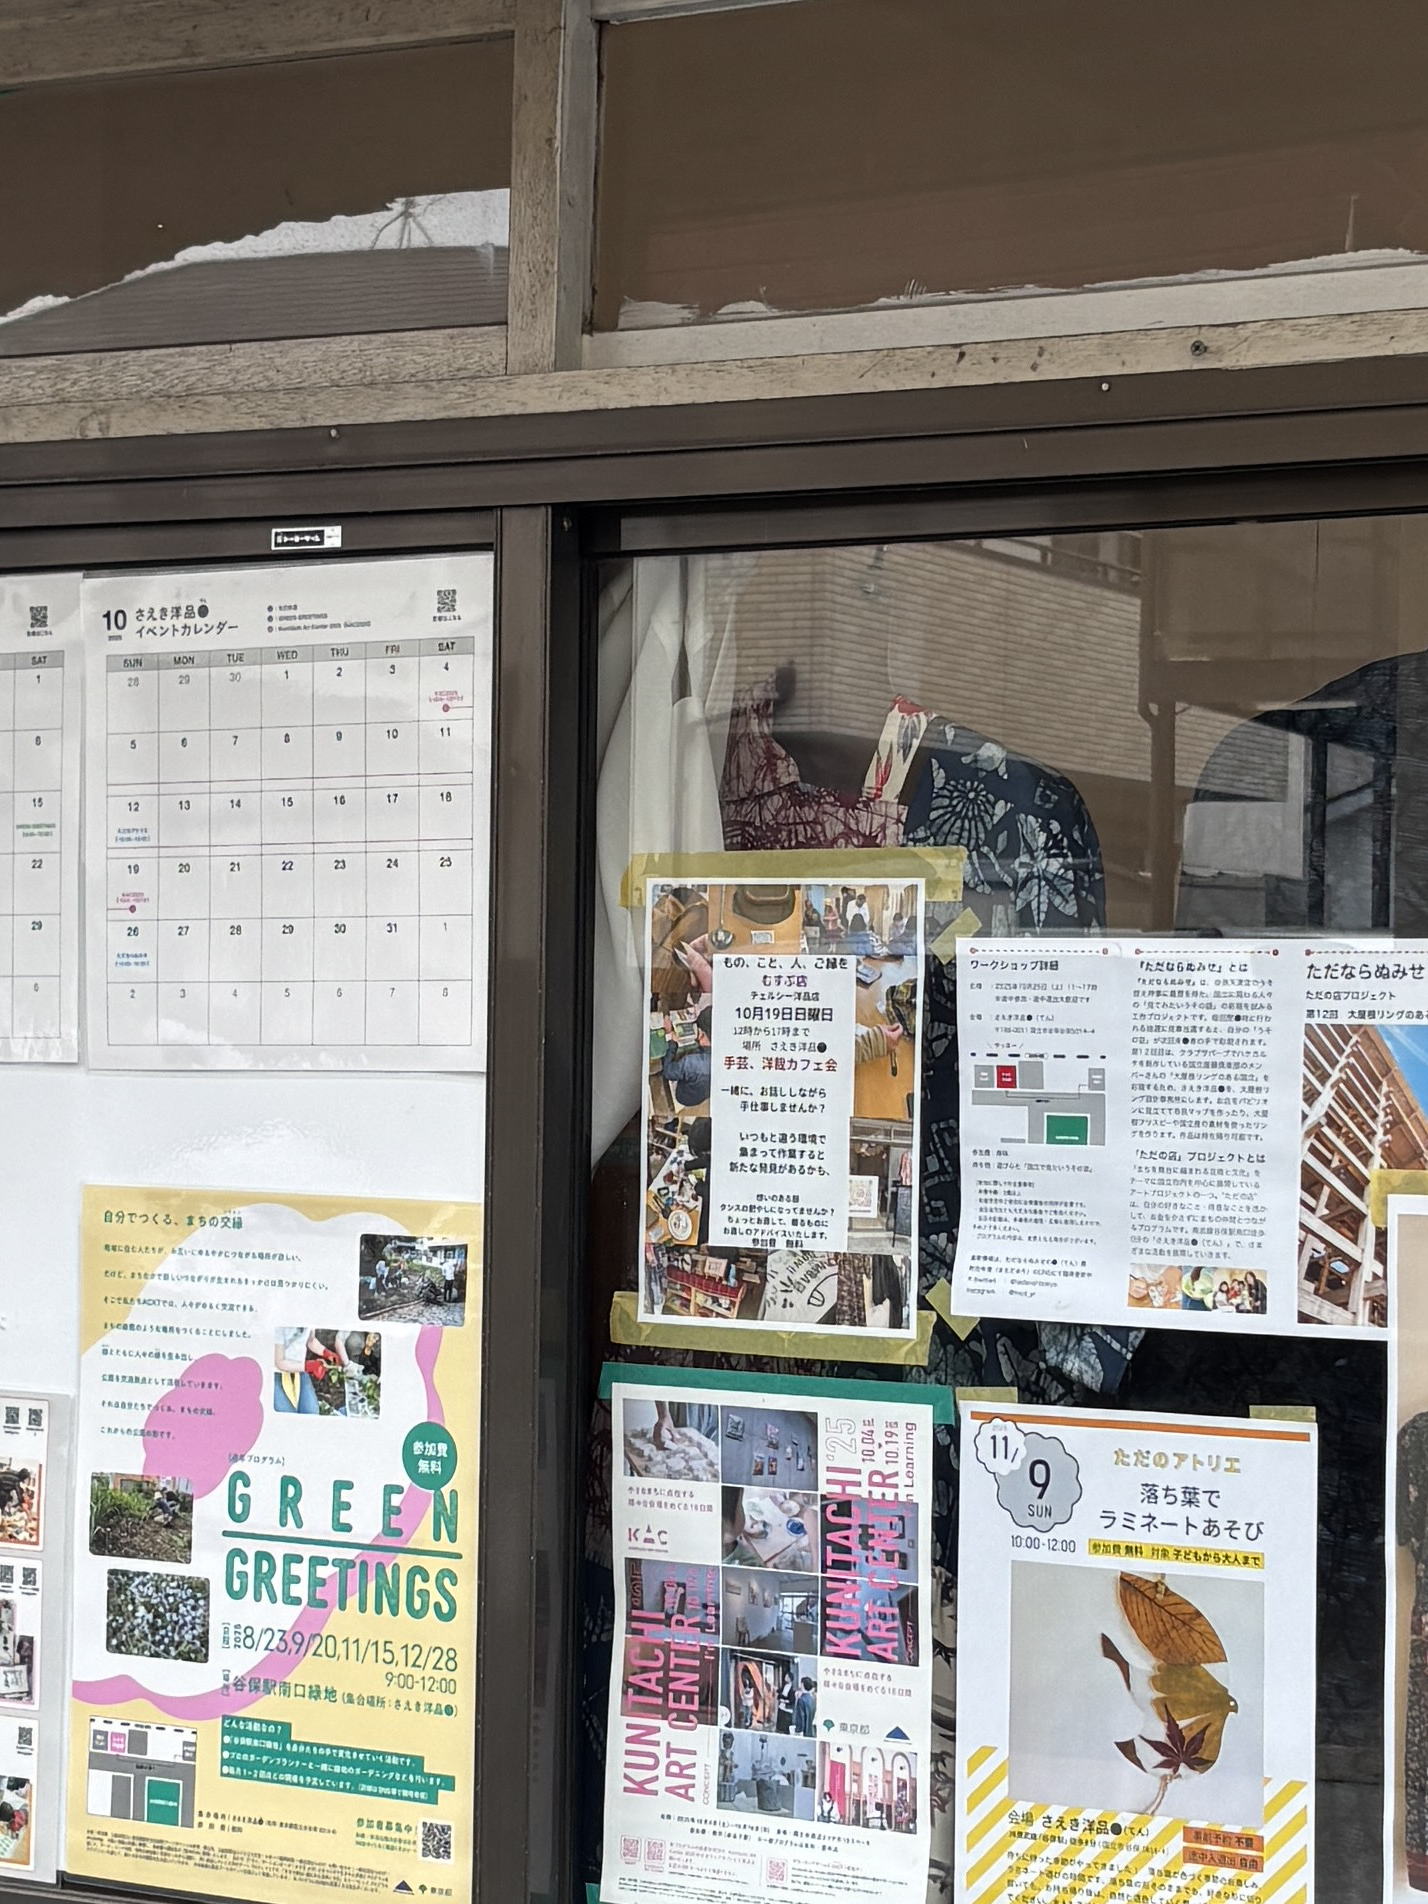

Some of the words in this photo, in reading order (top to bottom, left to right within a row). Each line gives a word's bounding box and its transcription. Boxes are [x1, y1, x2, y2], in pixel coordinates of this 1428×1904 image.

[102, 608, 127, 631] 10
[135, 622, 239, 639] イベントカレンダー
[31, 656, 47, 665] SAT
[123, 658, 143, 668] SUN
[173, 655, 195, 665] MON
[226, 653, 245, 662] TUE
[276, 650, 299, 659] WED
[330, 647, 349, 657] THU
[385, 645, 400, 654] FRI
[437, 642, 456, 651] SAT
[386, 729, 399, 739] 10
[440, 727, 451, 736] 11
[32, 798, 44, 807] 15
[127, 802, 140, 811] 12
[178, 800, 191, 810] 13
[230, 799, 242, 808] 14
[282, 797, 294, 807] 15
[333, 795, 346, 805] 16
[387, 794, 399, 803] 17
[440, 792, 453, 802] 18
[31, 859, 43, 868] 22
[127, 864, 140, 874] 19
[178, 863, 191, 873] 20
[229, 862, 241, 871] 21
[281, 861, 294, 870] 22
[334, 860, 347, 869] 23
[386, 859, 399, 868] 24
[439, 857, 453, 867] 25
[31, 921, 43, 930] 29
[127, 927, 139, 936] 26
[177, 926, 190, 935] 27
[229, 925, 242, 935] 28
[281, 925, 295, 934] 29
[334, 924, 347, 933] 30
[386, 923, 398, 933] 31
[1306, 963, 1425, 980] ただならぬみせ
[761, 974, 808, 988] むすぶ店
[1305, 990, 1396, 1001] ただの店プロジェクト
[735, 1006, 833, 1022] 10月19日日曜日
[1305, 1009, 1339, 1020] 第12回
[733, 1026, 810, 1037] 12時から17時まで
[742, 1041, 761, 1052] 場所
[723, 1056, 838, 1072] 手芸、洋裁カフェ会
[739, 1132, 827, 1145] いつもと違う環境で
[739, 1146, 825, 1161] 集まって作業すると
[412, 1441, 448, 1458] 参加費
[418, 1459, 443, 1475] 無料
[1113, 1447, 1242, 1474] ただのアトリエ
[1029, 1458, 1051, 1500] 9
[1140, 1482, 1221, 1509] 落ち葉で
[227, 1470, 459, 1544] GREEN
[1028, 1504, 1053, 1519] SUN
[867, 1469, 900, 1591] CENTER
[1099, 1508, 1266, 1542] ラミネートあそび
[1011, 1534, 1076, 1554] 10:00-12:00
[825, 1465, 862, 1657] KUNITACHI
[1092, 1541, 1122, 1556] 参加費
[1172, 1547, 1261, 1567] 子どもから大人まで
[225, 1547, 459, 1623] GREETINGS
[867, 1606, 900, 1662] ART
[242, 1624, 458, 1672] 8/23,9/20,11/15,12/28
[668, 1613, 701, 1732] CENTER
[233, 1675, 338, 1703] 谷保駅南口緑地
[385, 1672, 457, 1695] 9:00-12:00
[622, 1609, 665, 1797] KUNITACHI
[664, 1741, 698, 1802] ART
[1008, 1809, 1034, 1827] 会場
